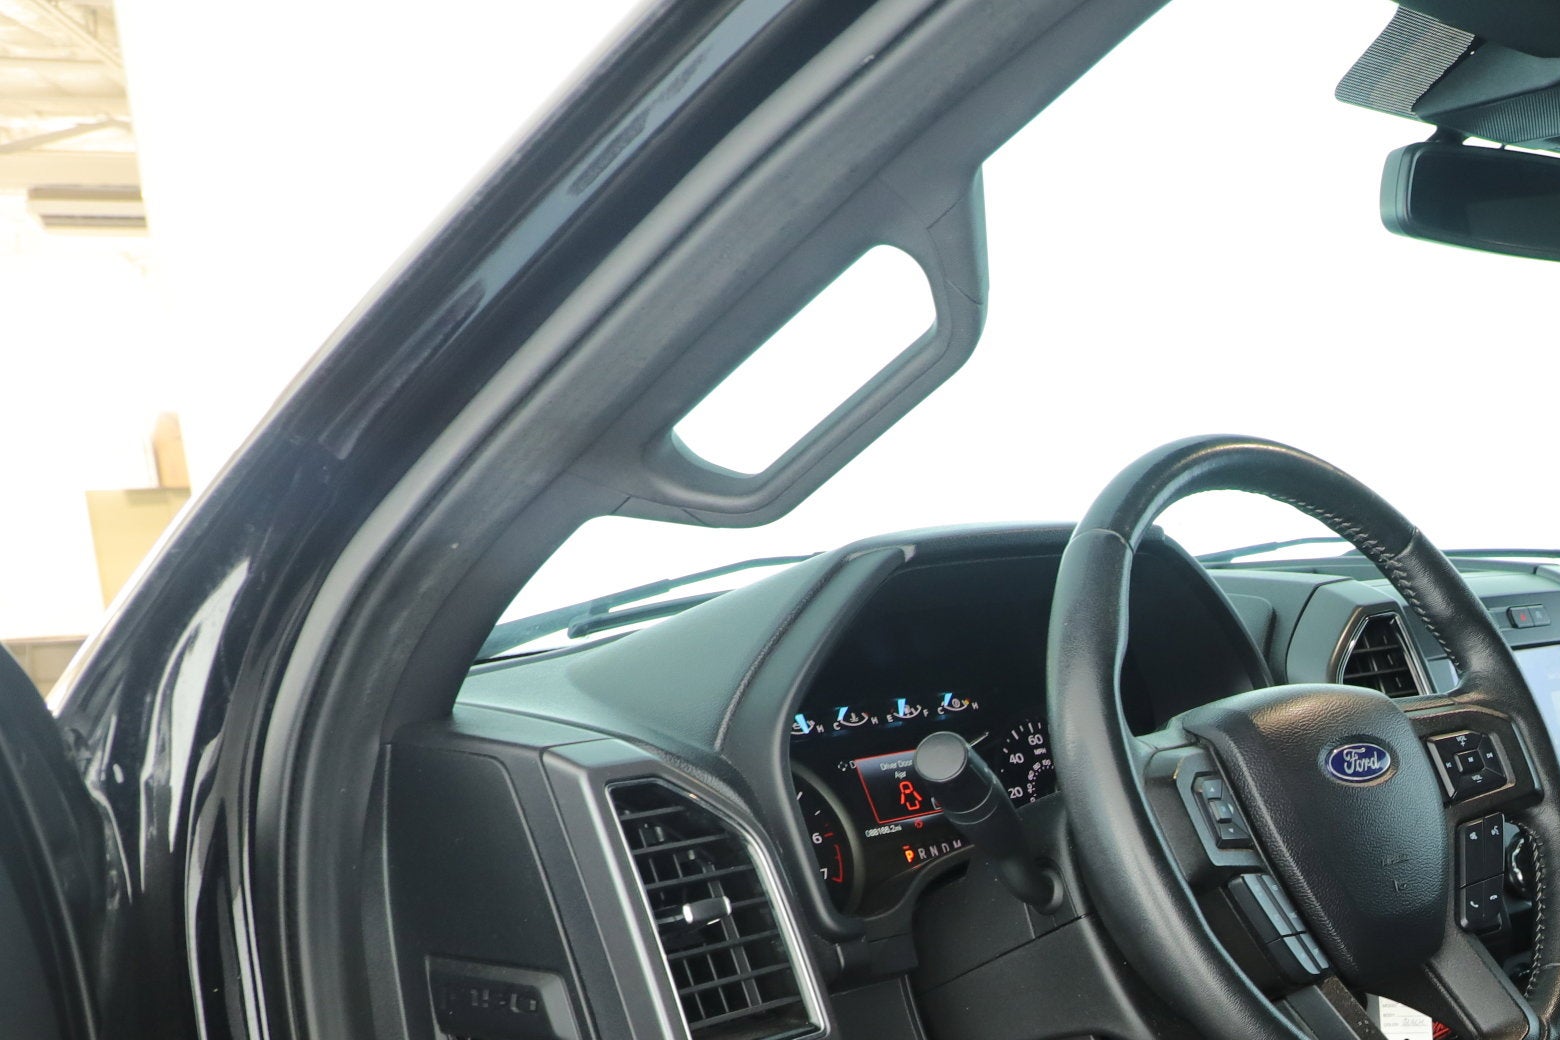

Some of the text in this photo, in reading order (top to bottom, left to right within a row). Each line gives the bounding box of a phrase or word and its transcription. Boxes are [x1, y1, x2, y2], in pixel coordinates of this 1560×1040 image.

[887, 714, 894, 723] E
[1028, 734, 1044, 746] 60
[1009, 753, 1024, 765] 40
[1343, 747, 1380, 774] Ford
[1008, 786, 1024, 799] 20
[811, 832, 822, 844] 6
[904, 849, 915, 863] P
[918, 848, 927, 859] R
[930, 846, 939, 857] N
[820, 868, 829, 880] 7
